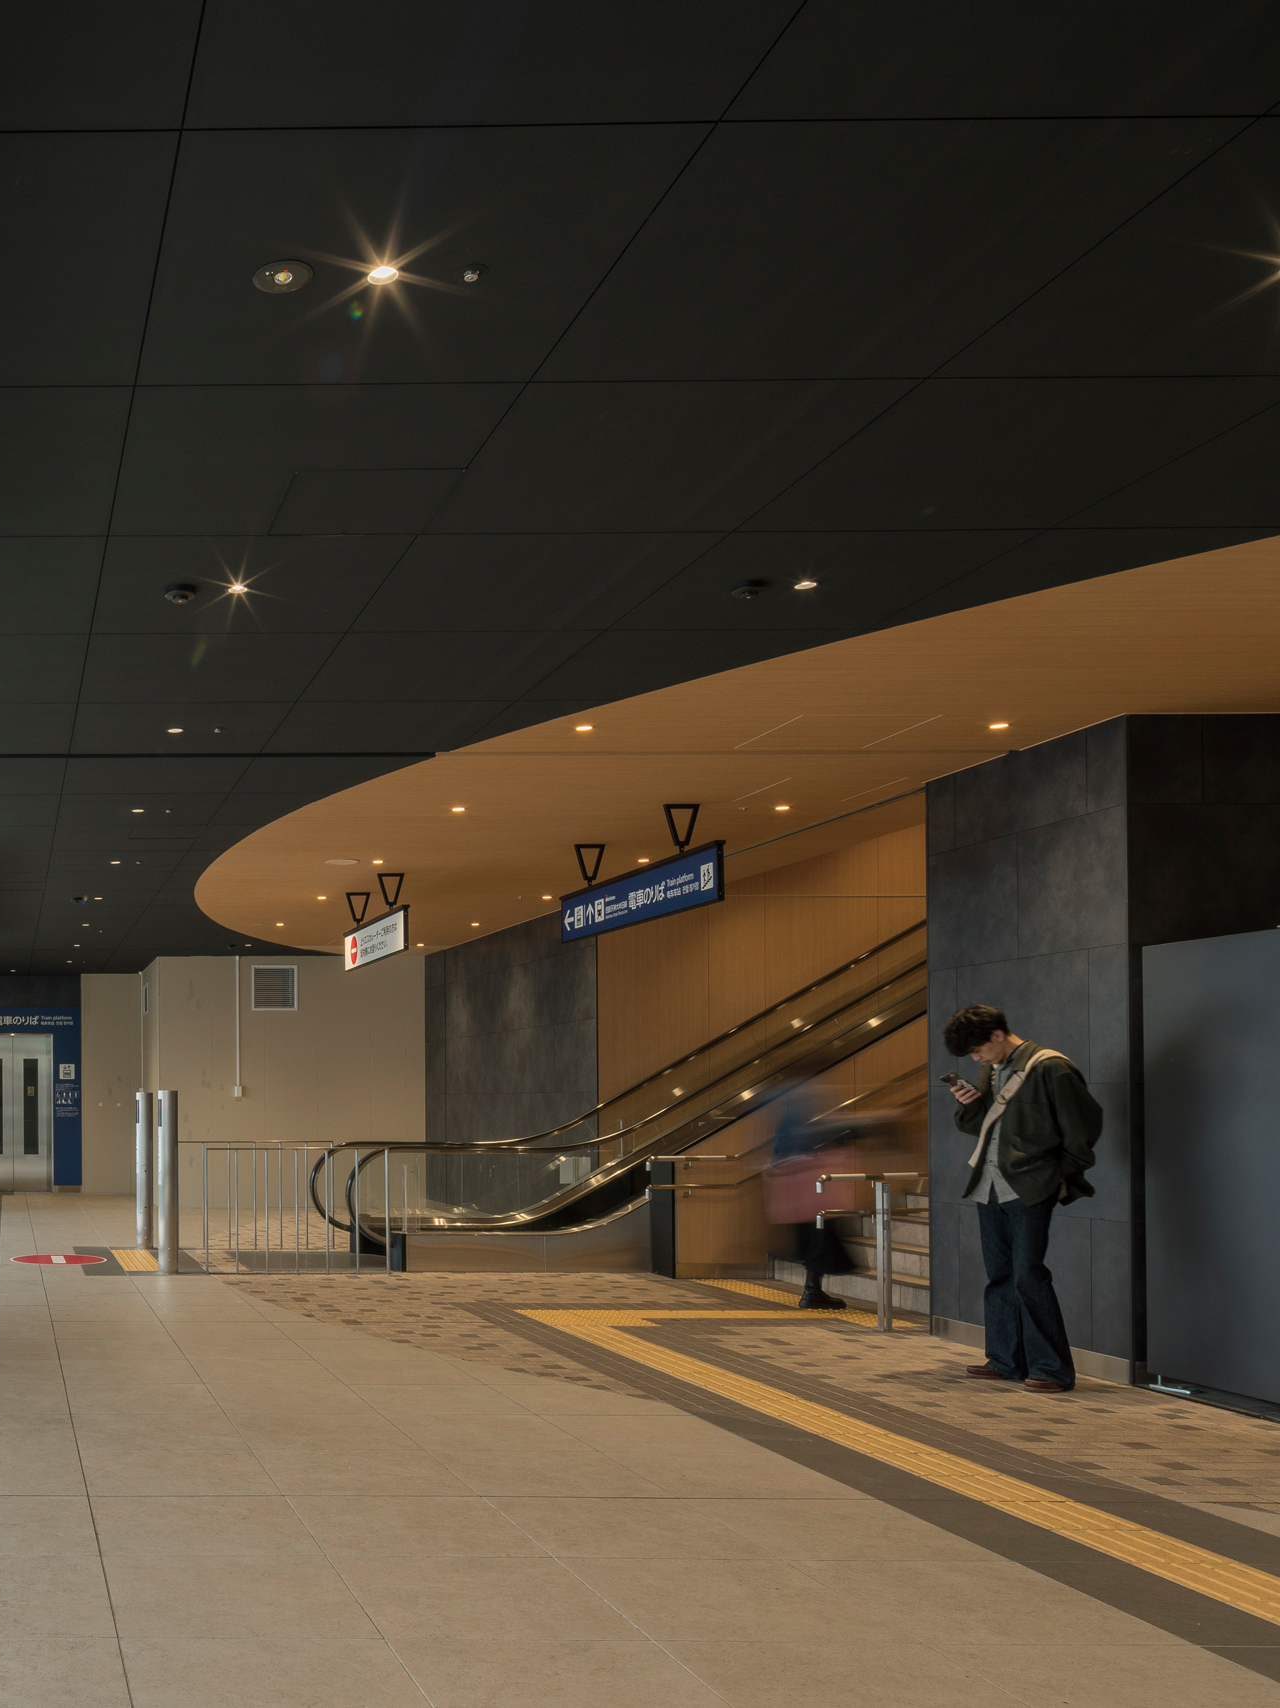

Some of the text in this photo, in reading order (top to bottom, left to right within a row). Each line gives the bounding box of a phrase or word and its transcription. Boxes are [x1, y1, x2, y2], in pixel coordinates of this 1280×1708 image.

[666, 873, 694, 887] Train platform
[628, 881, 666, 910] 電車のりば
